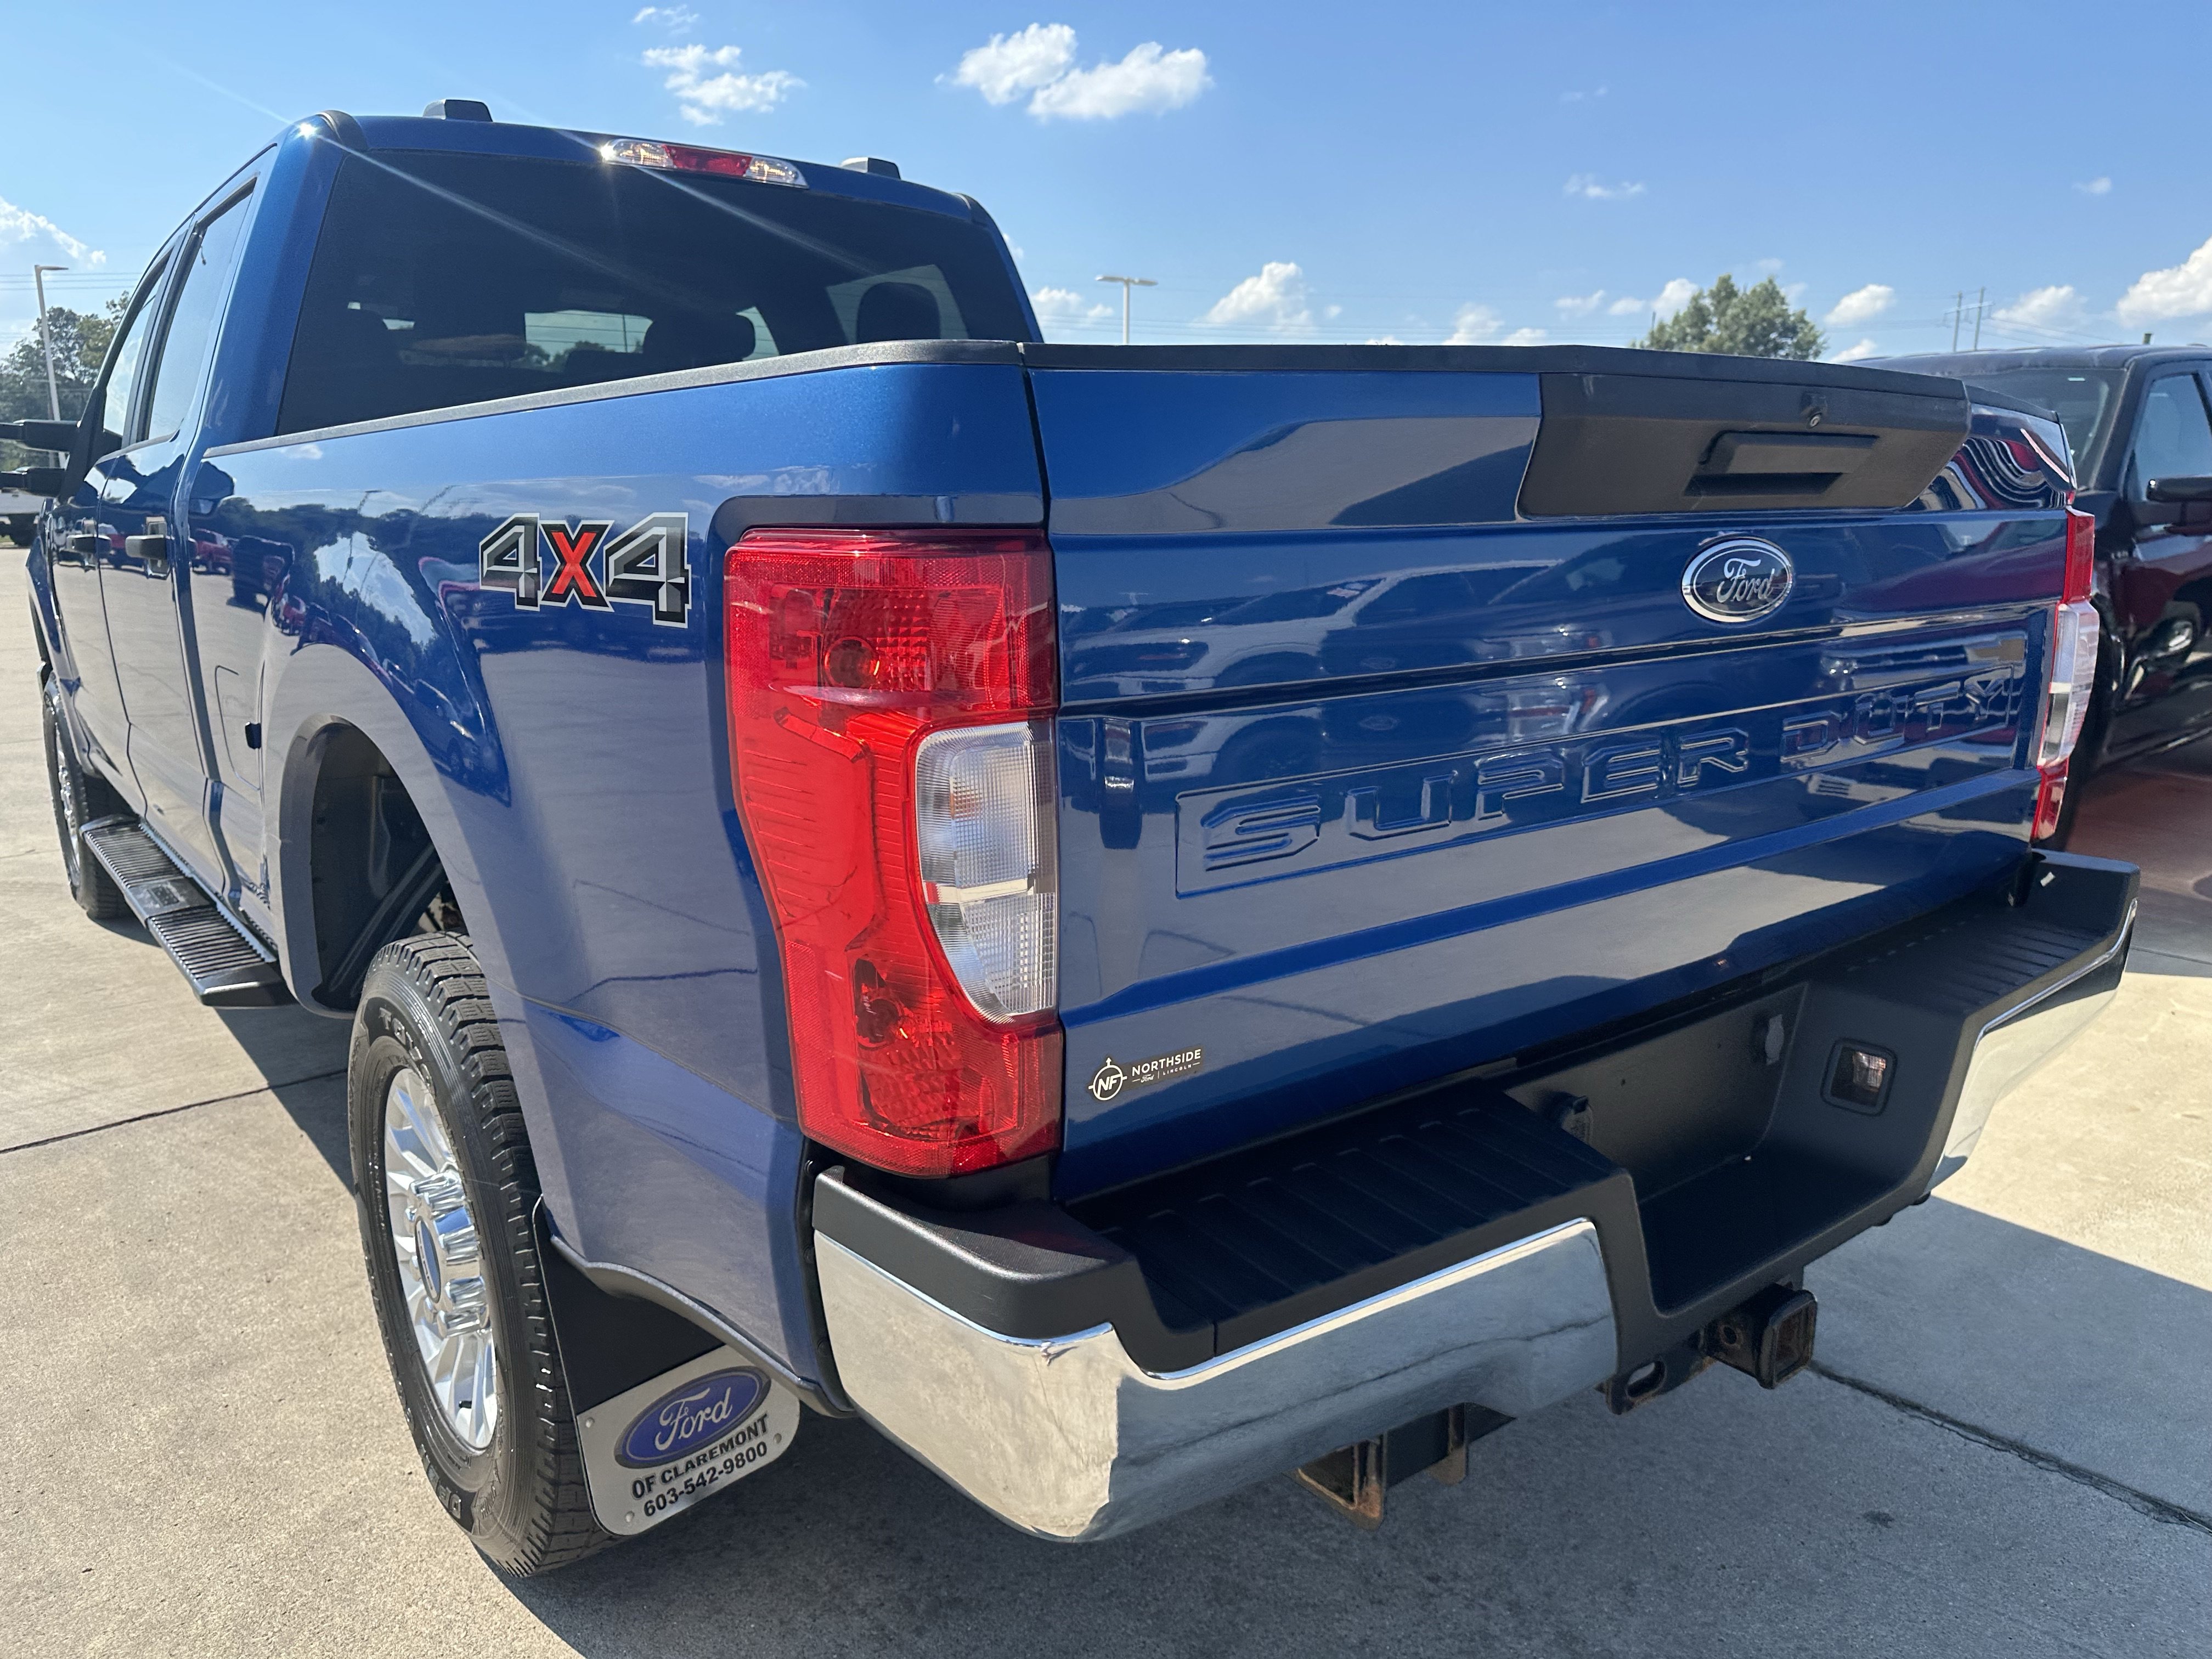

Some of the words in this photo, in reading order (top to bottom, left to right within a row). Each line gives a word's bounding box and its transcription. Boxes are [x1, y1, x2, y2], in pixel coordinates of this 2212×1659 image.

[1716, 557, 1775, 603] Ford
[1200, 727, 1750, 871] SUPER
[1780, 677, 2006, 763] DUTY
[1132, 1048, 1201, 1077] NORTHSIDE
[1140, 1073, 1155, 1083] Ford
[1163, 1064, 1192, 1076] LINCOLN
[654, 1387, 732, 1451] Ford
[632, 1475, 656, 1499] OF
[660, 1413, 768, 1486] CLAREMONT
[644, 1441, 768, 1517] 603-542-9800
